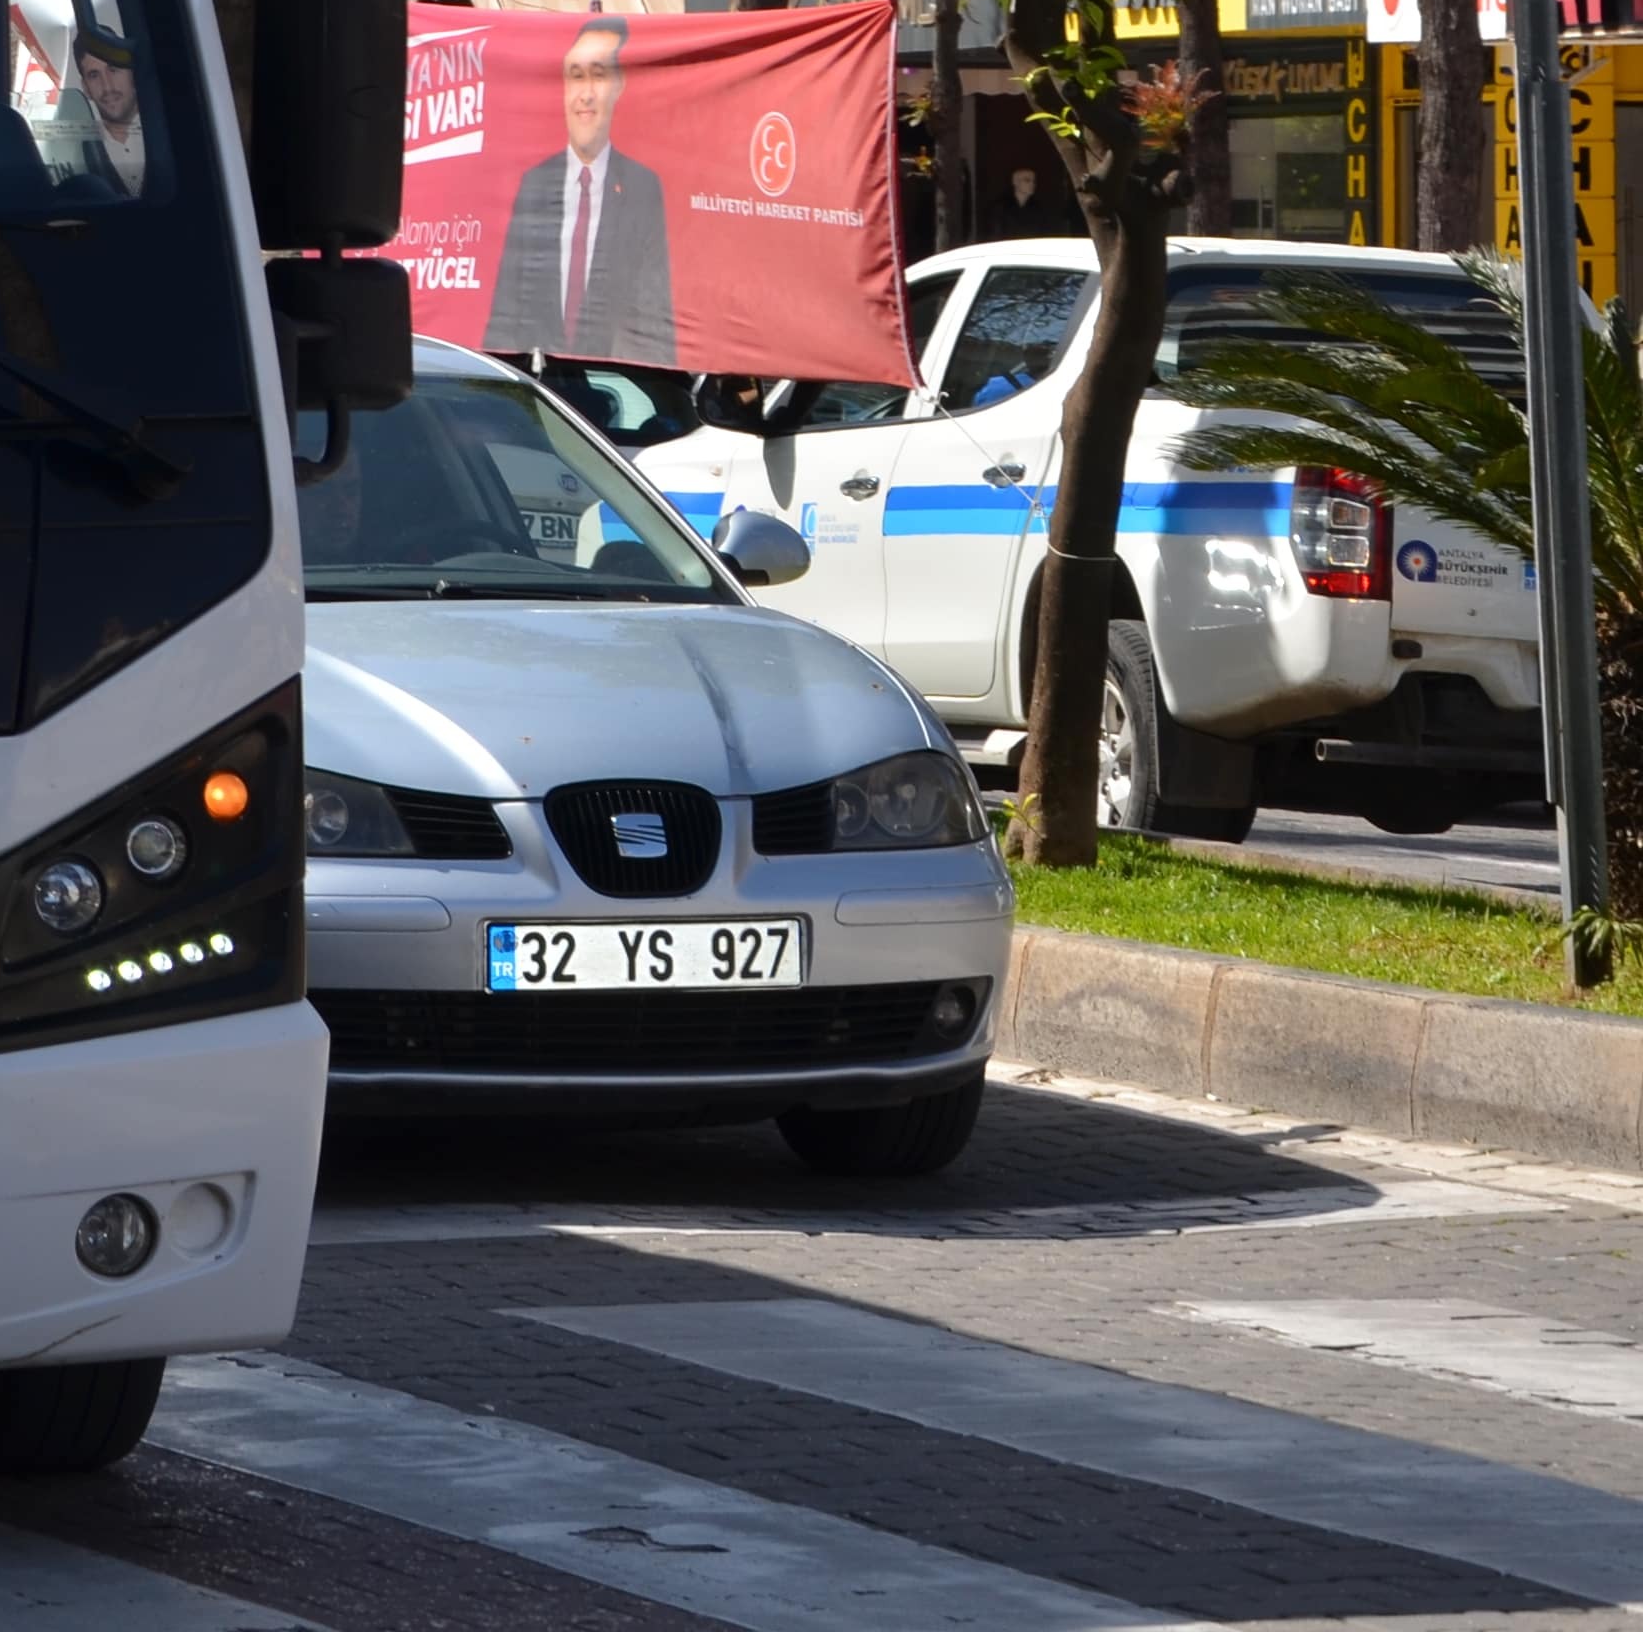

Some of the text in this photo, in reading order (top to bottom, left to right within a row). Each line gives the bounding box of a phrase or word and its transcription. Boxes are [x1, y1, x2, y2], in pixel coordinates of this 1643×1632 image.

[426, 81, 484, 135] VAR!
[690, 192, 864, 228] MİLLİYETÇİ HAREKET PARTİSİ
[452, 214, 482, 252] için
[416, 247, 480, 290] YÜCEL
[1437, 560, 1508, 576] BÜYÜKŞEHİR
[1438, 549, 1485, 560] ANTALYA
[492, 927, 790, 983] TR 32 YS 927
